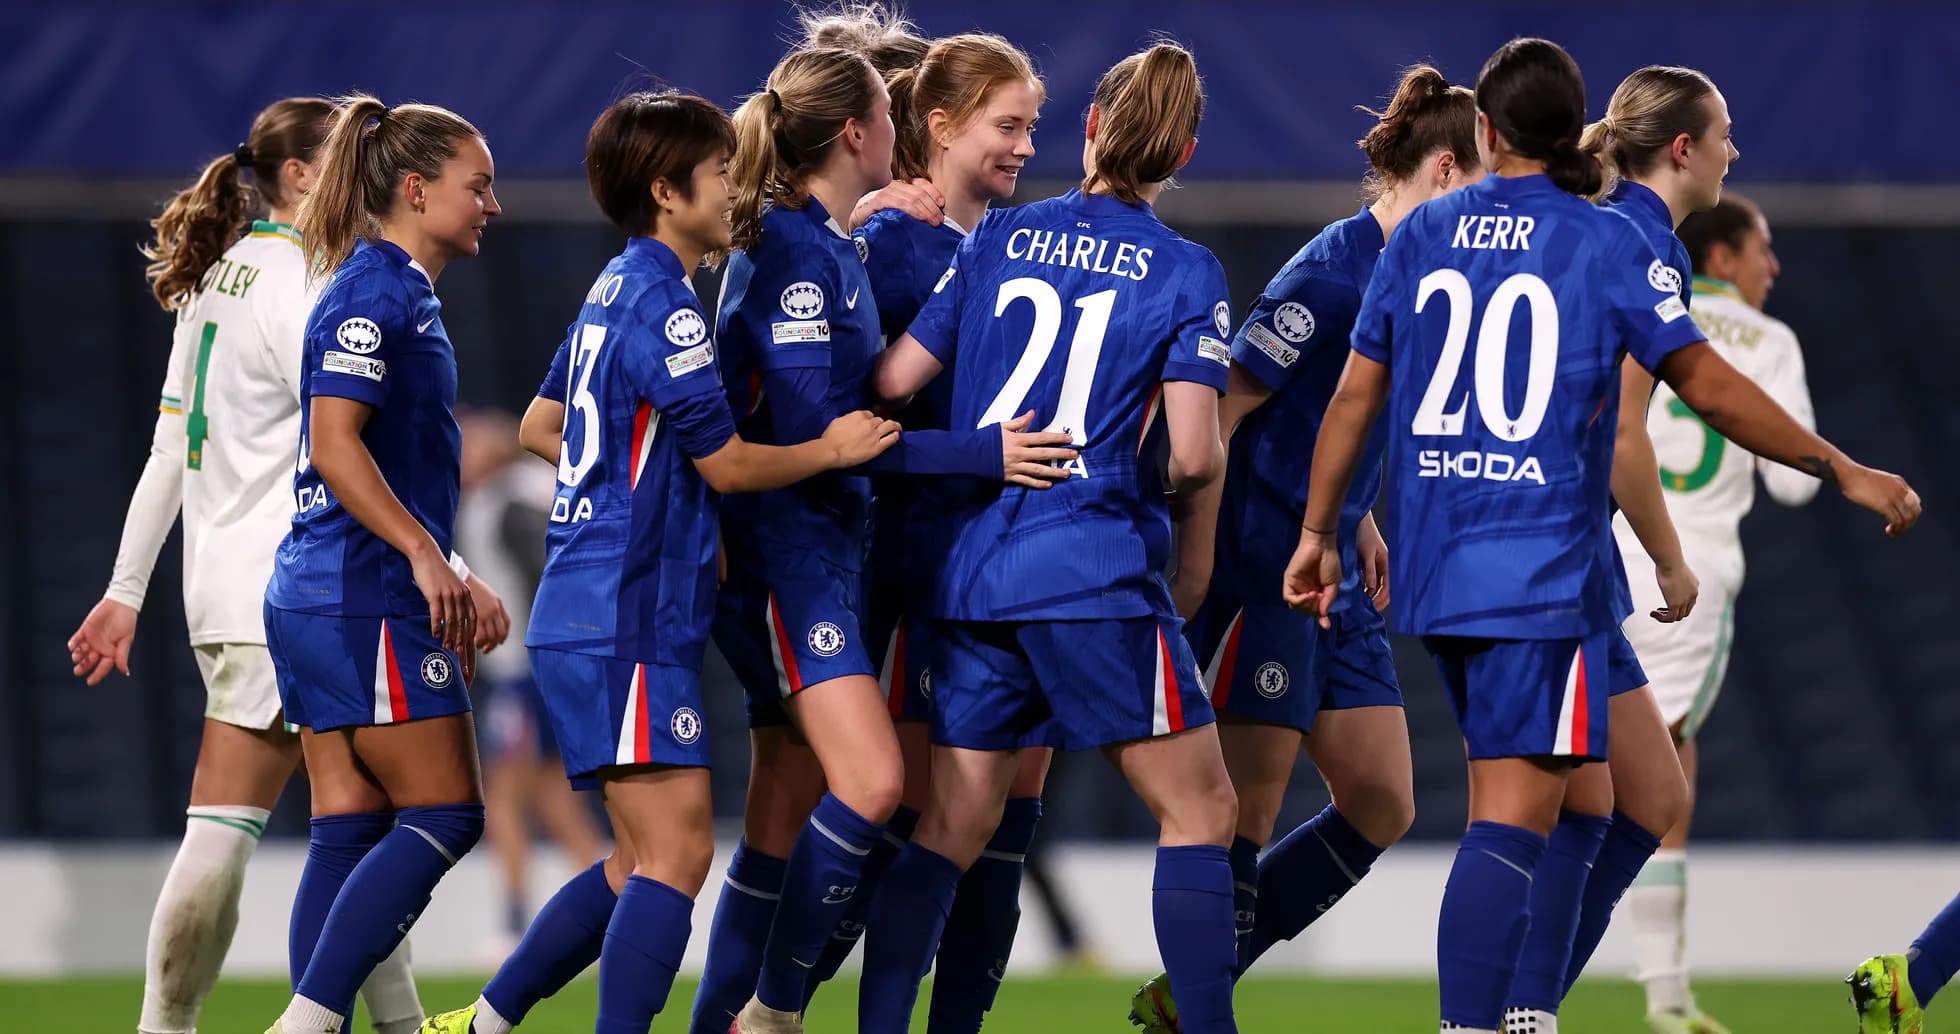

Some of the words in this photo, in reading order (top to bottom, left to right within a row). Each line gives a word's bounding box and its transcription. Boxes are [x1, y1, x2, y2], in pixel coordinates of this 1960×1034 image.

[1006, 228, 1154, 281] CHARLES
[1451, 215, 1535, 251] KERR
[186, 320, 218, 471] 4
[976, 277, 1118, 447] 21
[1411, 268, 1560, 442] 20
